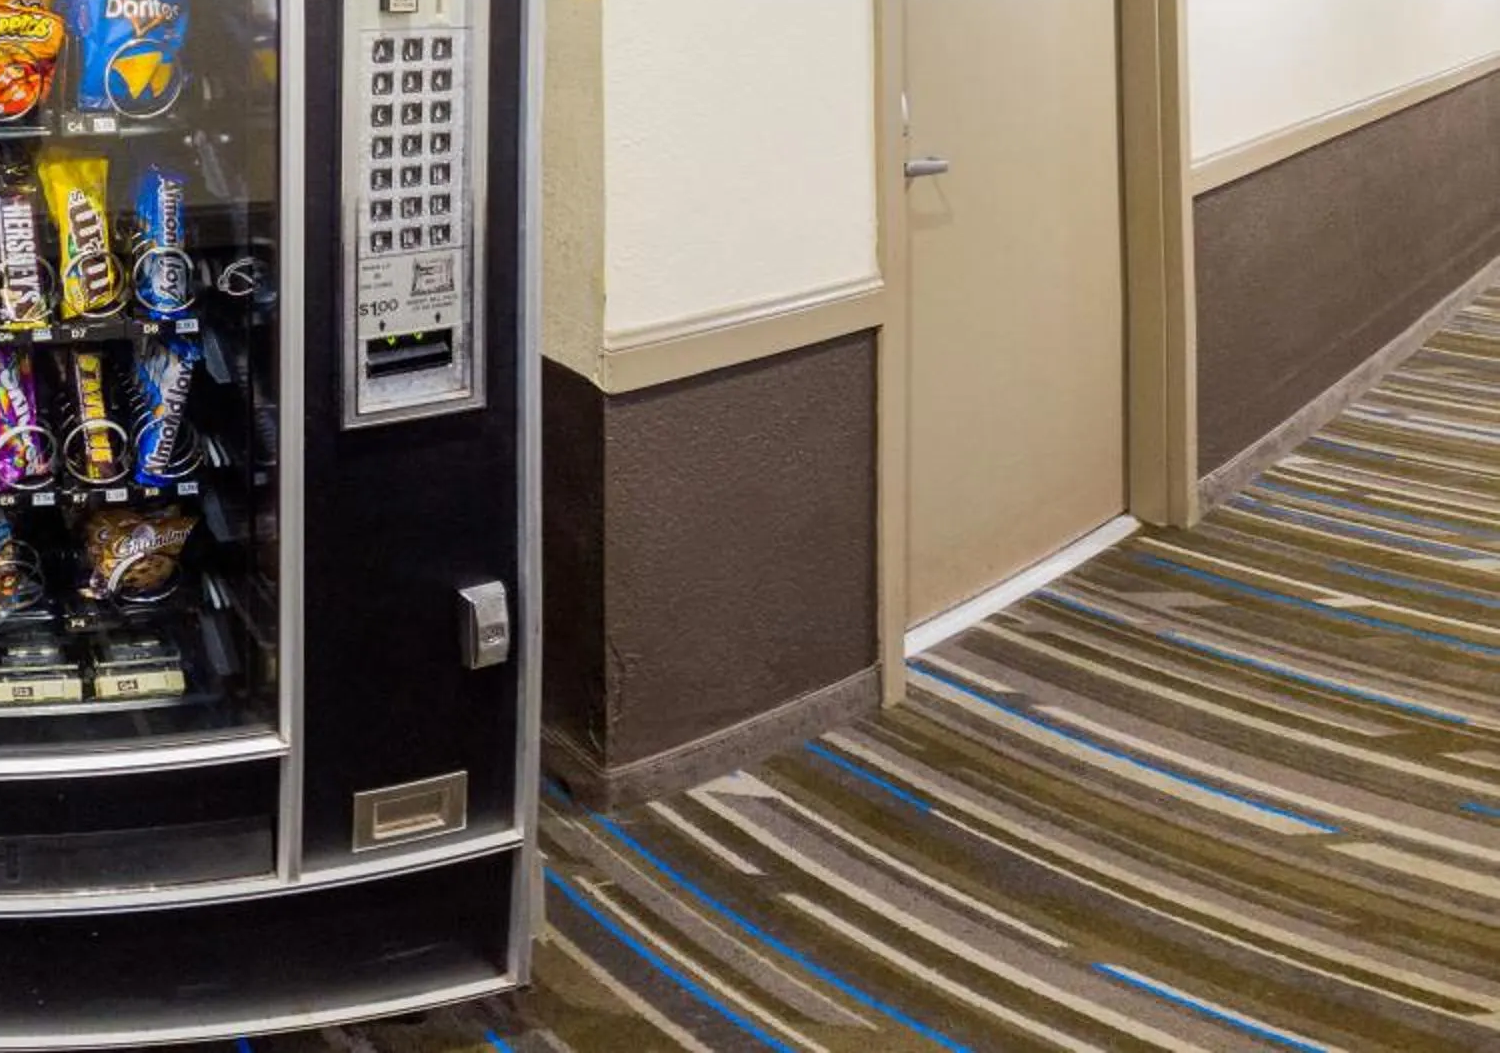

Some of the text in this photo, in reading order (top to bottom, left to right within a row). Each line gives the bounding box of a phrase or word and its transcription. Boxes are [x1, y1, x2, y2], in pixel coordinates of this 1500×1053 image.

[68, 122, 84, 132] C4
[358, 298, 399, 317] $1.00
[71, 328, 87, 338] D7
